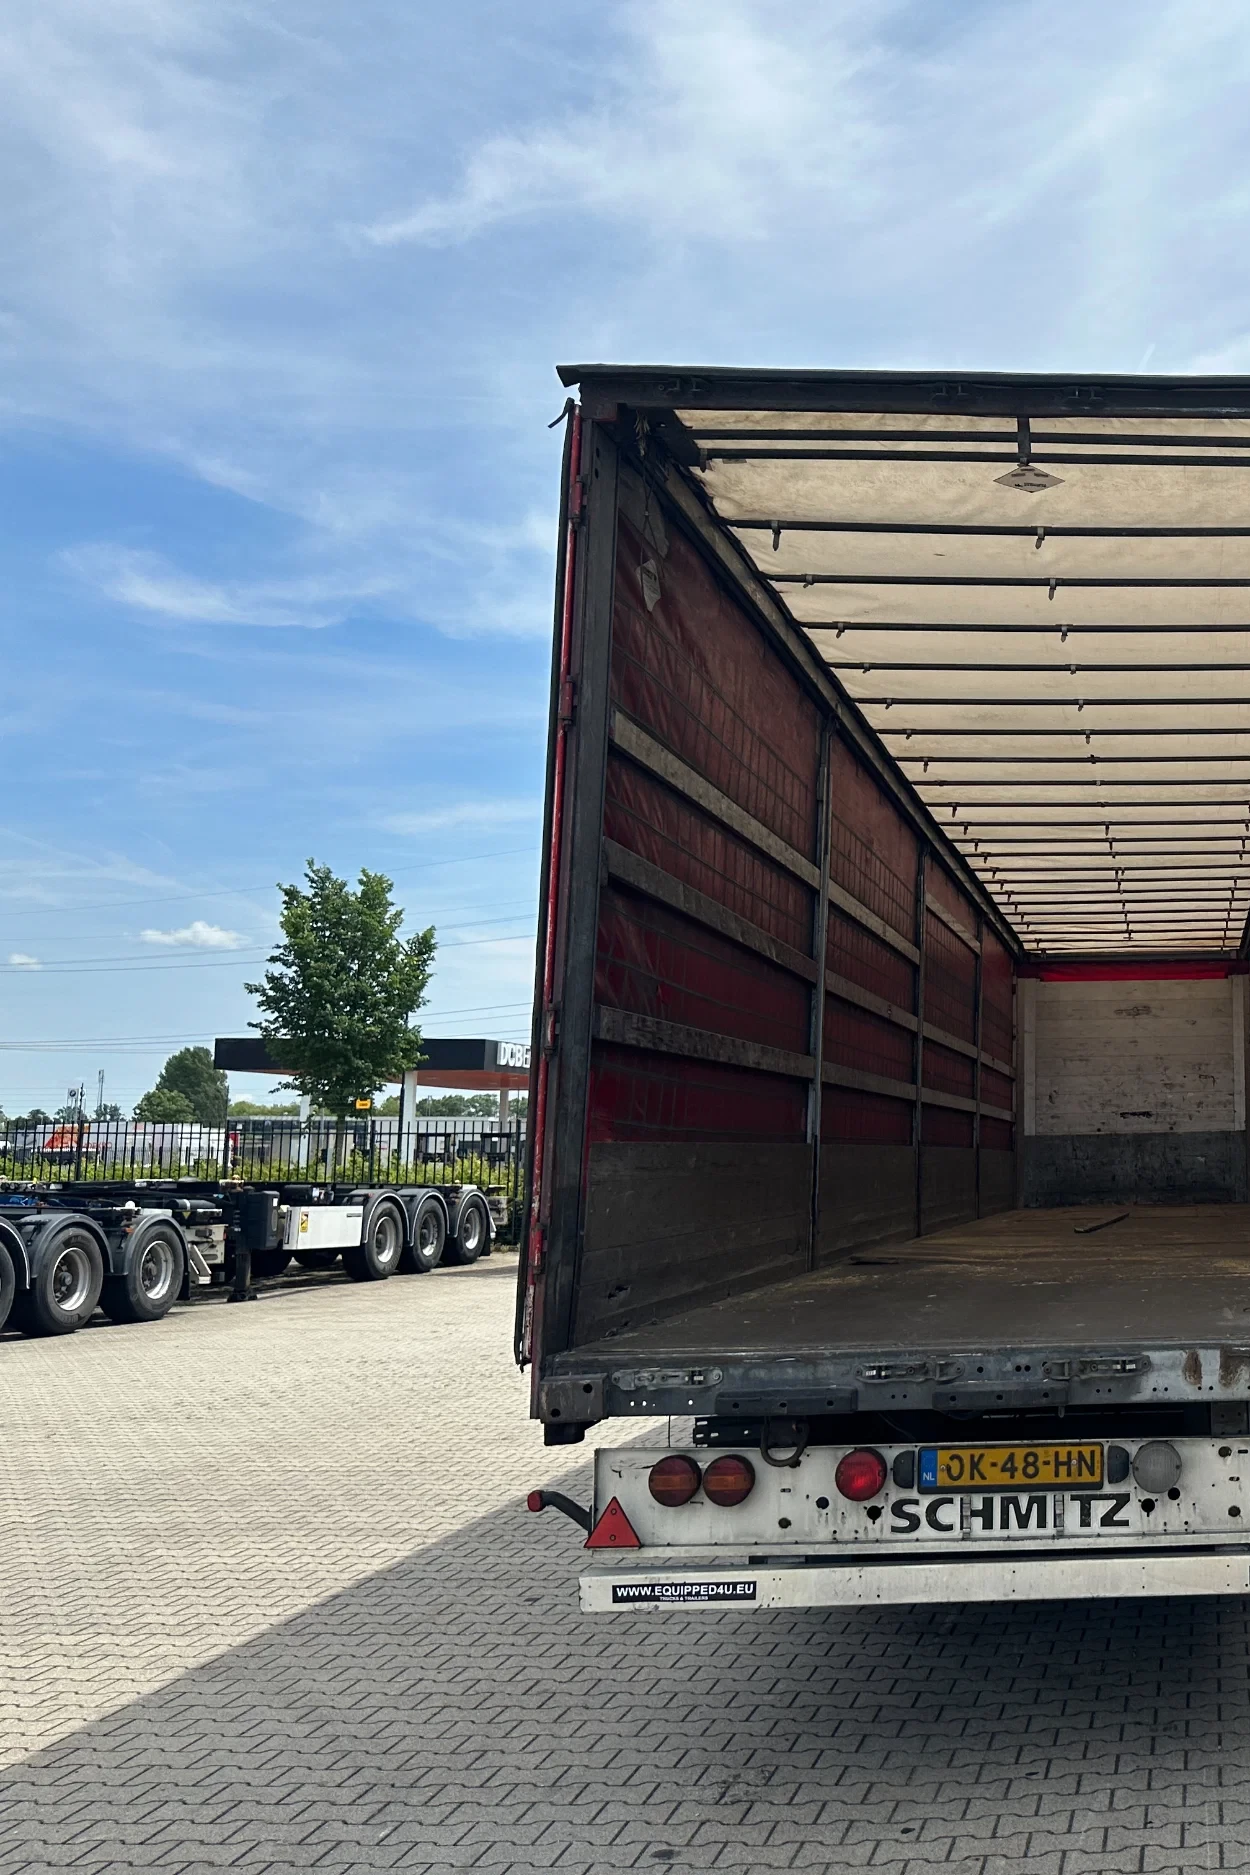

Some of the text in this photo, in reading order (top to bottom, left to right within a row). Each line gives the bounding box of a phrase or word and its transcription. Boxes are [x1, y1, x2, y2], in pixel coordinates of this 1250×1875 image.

[946, 1450, 1096, 1482] OK-48-HN
[922, 1471, 935, 1481] NL
[616, 1584, 754, 1597] WWW.EQUIPPED4U.EU
